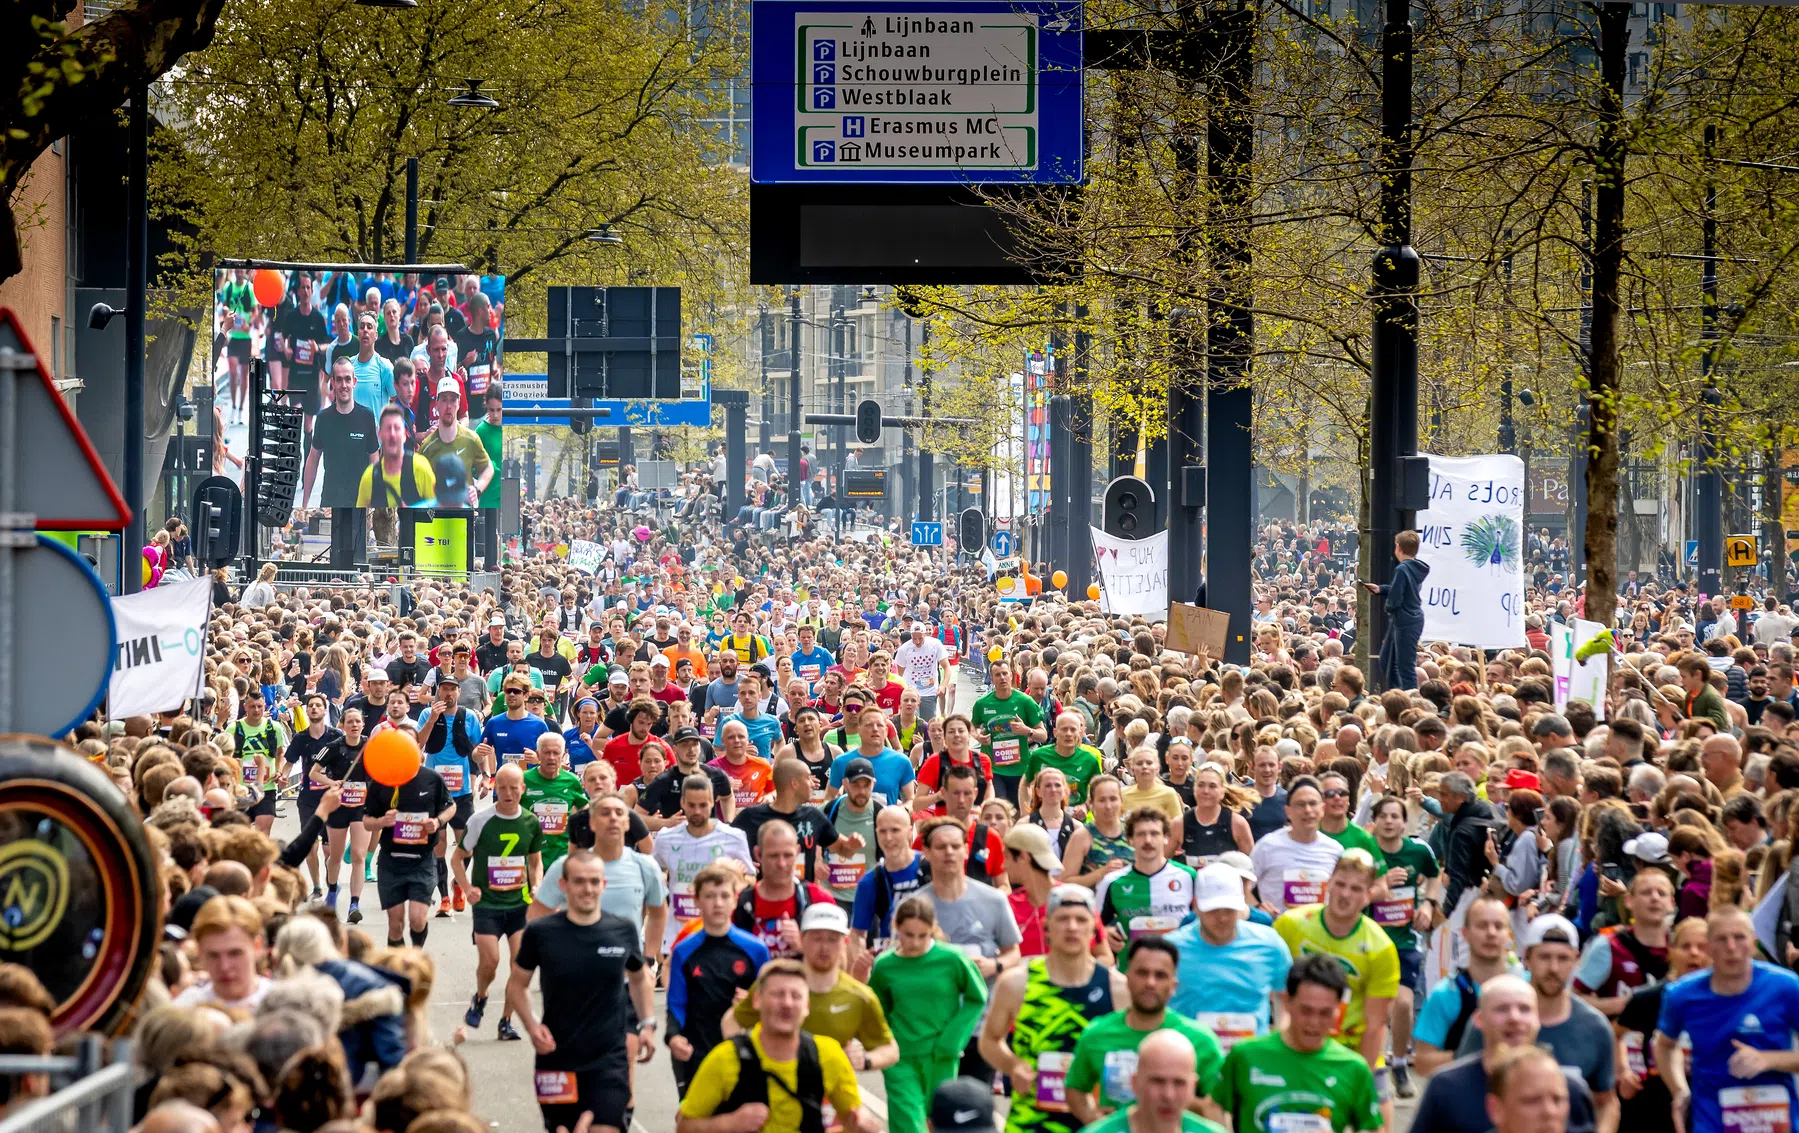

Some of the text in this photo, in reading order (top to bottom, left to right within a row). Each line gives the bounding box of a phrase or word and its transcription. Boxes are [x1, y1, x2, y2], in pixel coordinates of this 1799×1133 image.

[885, 17, 974, 37] Lijnbaan
[841, 41, 930, 61] Lijnbaan
[841, 65, 1021, 85] Schouwburgplein
[842, 89, 952, 106] Westblaak
[870, 118, 958, 134] Erasmus
[966, 118, 997, 135] MC
[865, 142, 1000, 162] Museumpark
[538, 815, 563, 824] DAVE
